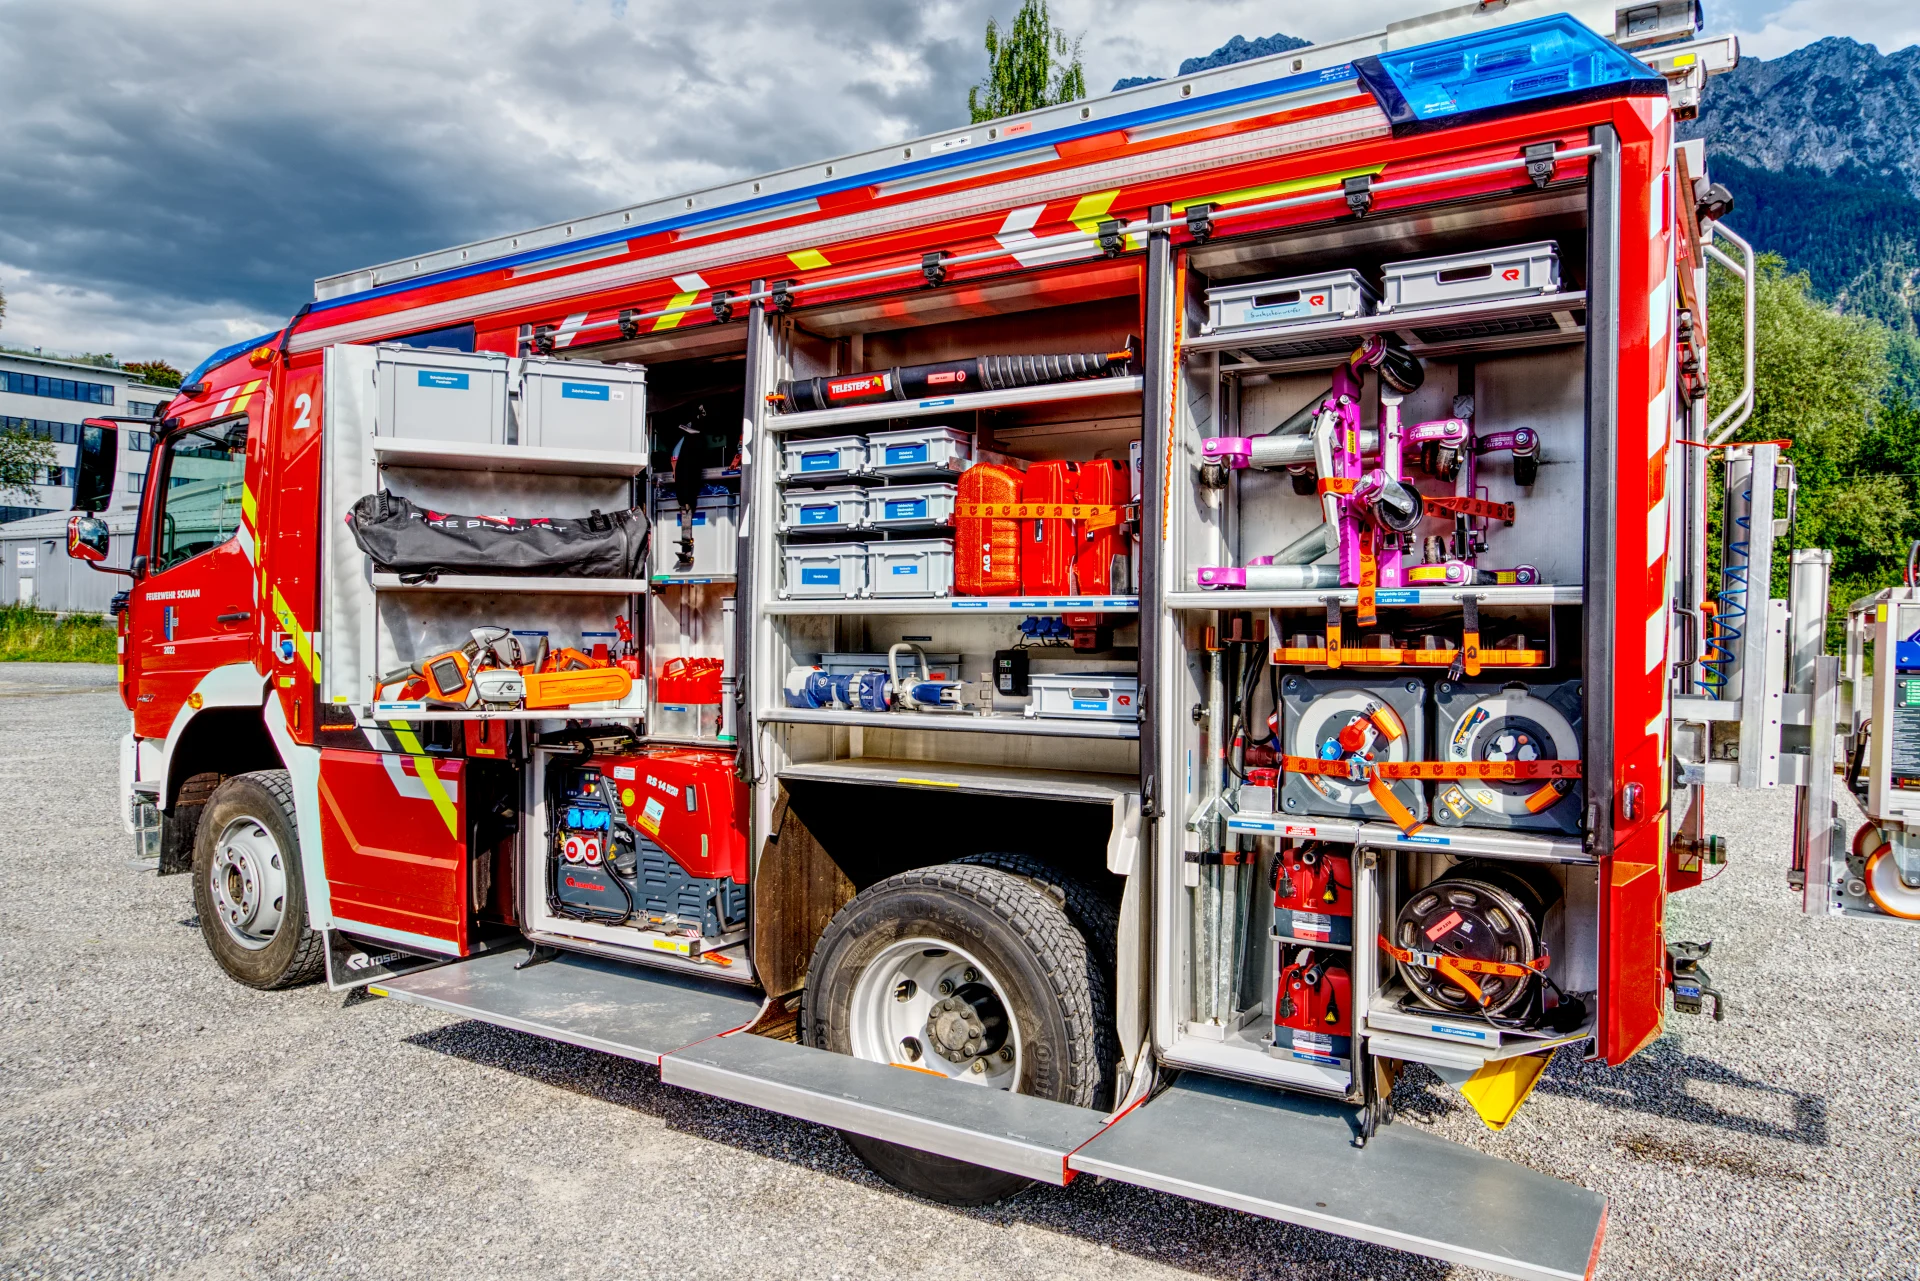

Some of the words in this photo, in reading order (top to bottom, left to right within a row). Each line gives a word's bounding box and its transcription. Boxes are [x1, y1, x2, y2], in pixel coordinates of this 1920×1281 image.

[831, 380, 871, 395] TELESTEPS
[292, 392, 312, 430] 2
[409, 511, 459, 528] FIRE
[466, 519, 568, 533] BLANET
[983, 542, 991, 552] 4
[146, 591, 176, 601] FEUERWEHR
[177, 588, 200, 599] SCHAAN
[163, 646, 176, 655] 2022
[646, 774, 658, 787] RS
[658, 780, 667, 792] 14
